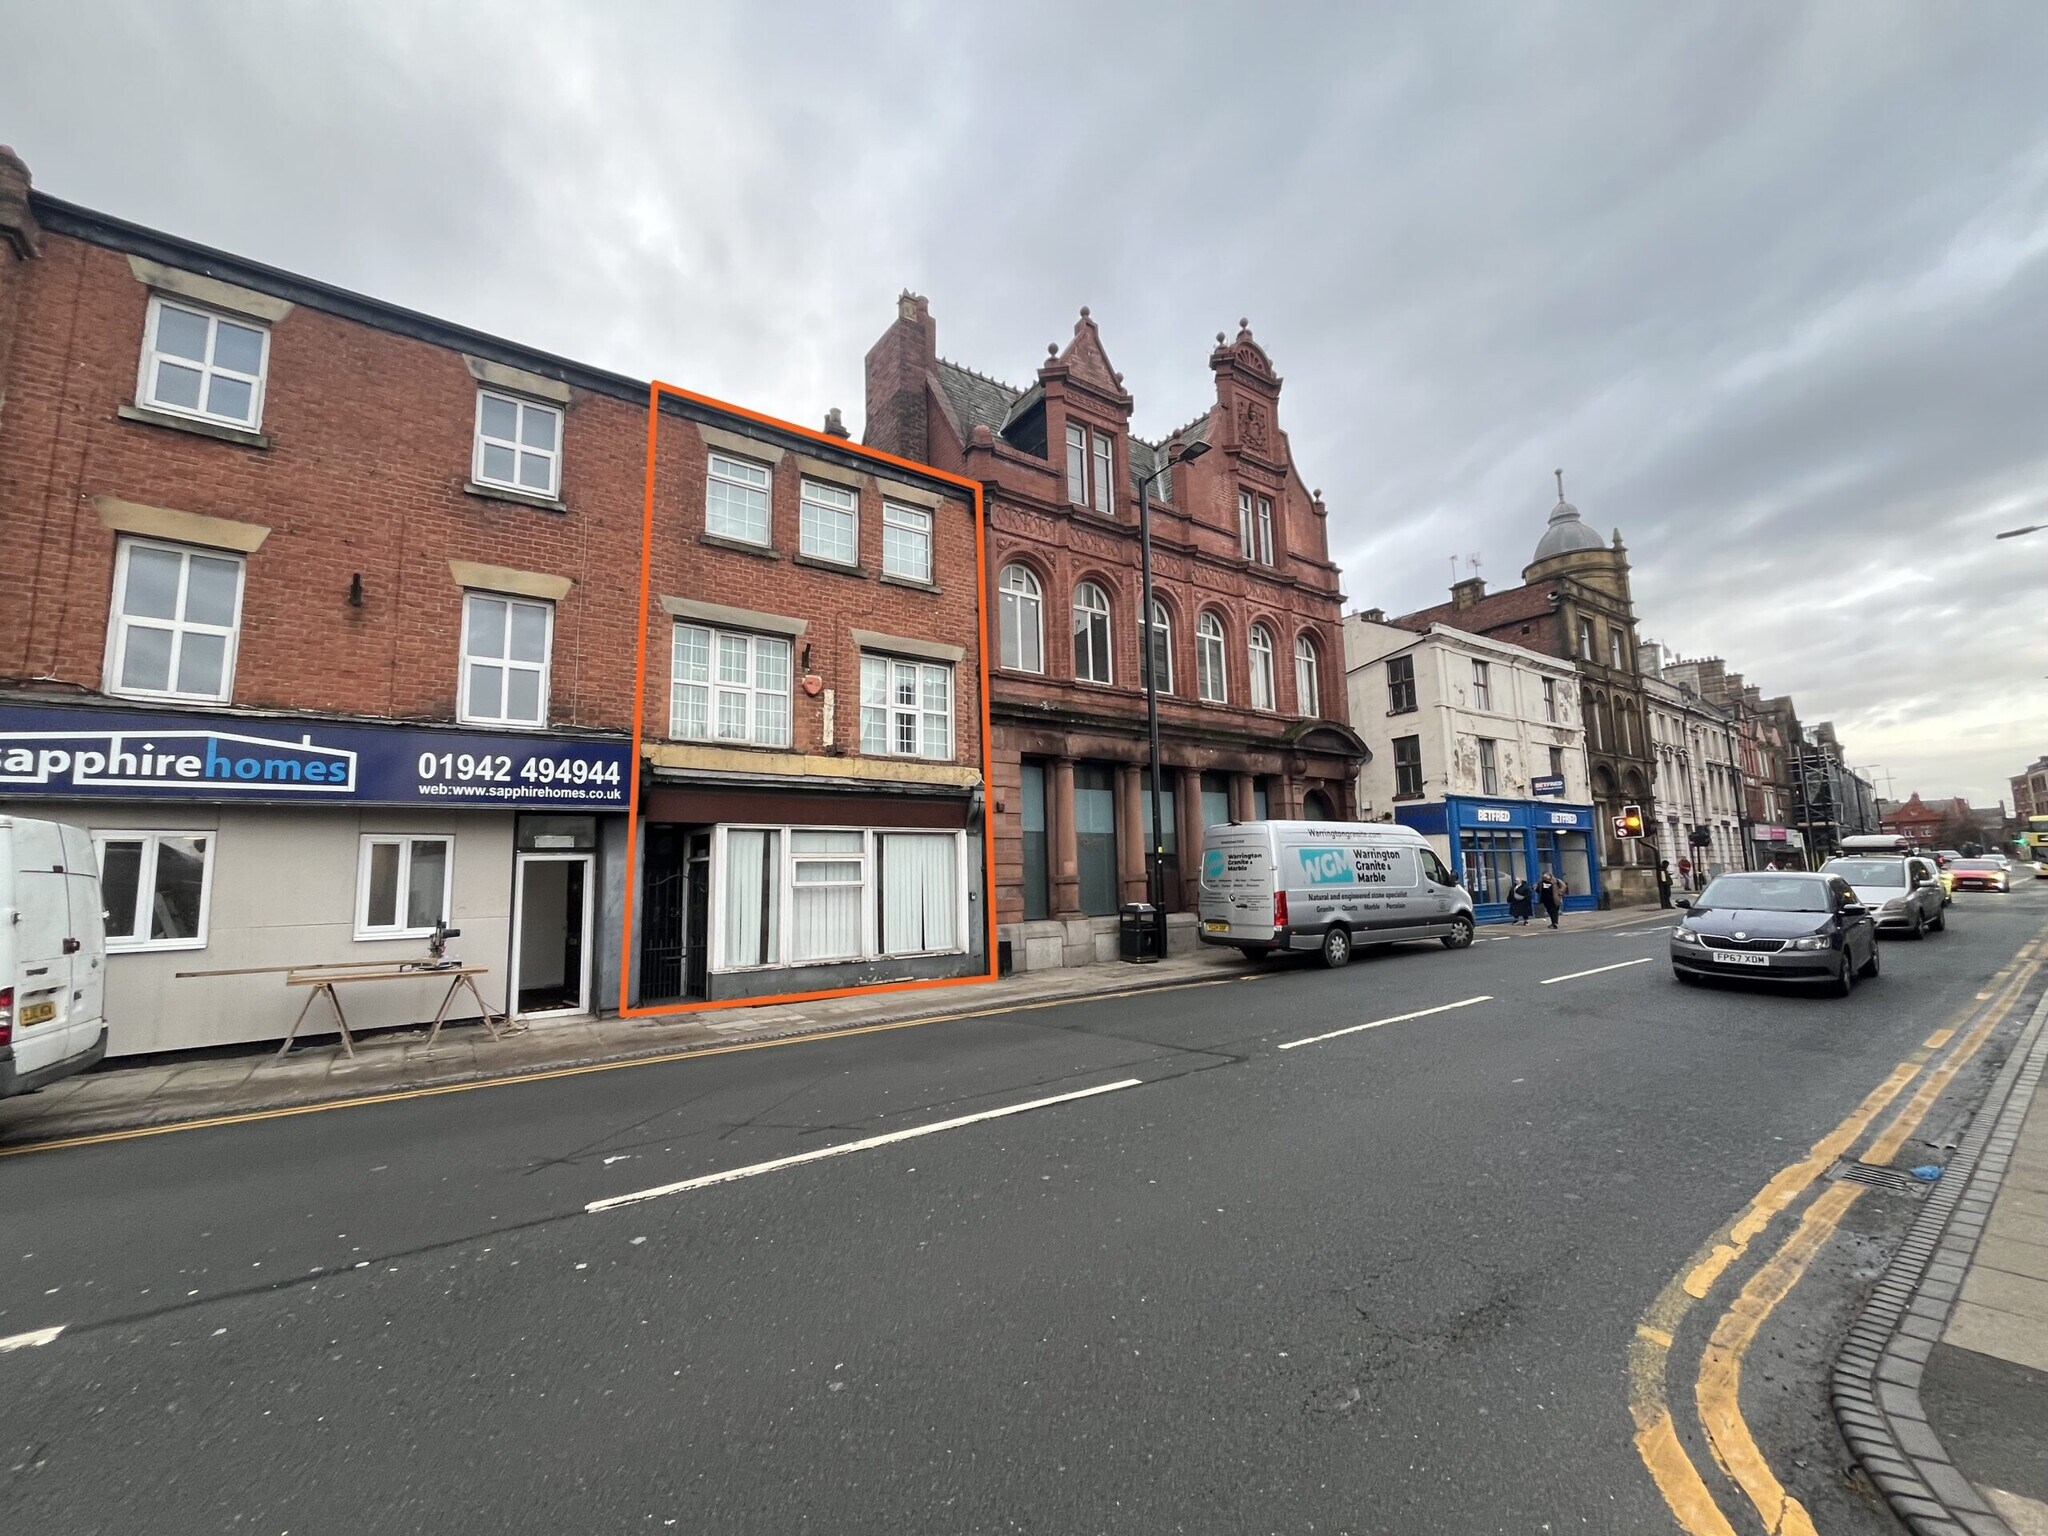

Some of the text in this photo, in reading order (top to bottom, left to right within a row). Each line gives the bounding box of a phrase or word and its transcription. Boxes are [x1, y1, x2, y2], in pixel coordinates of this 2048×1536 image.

[0, 736, 346, 784] apphirehomes
[419, 752, 620, 785] 01942 494944
[1535, 780, 1563, 788] BETFRED
[419, 783, 621, 800] web:www.sapphirehomes.co.uk
[1478, 809, 1510, 822] BETFRED
[1551, 812, 1577, 824] BETFRED
[1353, 849, 1400, 861] Warrington
[1301, 851, 1352, 884] WGM
[1356, 861, 1386, 871] Granite
[1358, 873, 1386, 882] Marble
[1308, 893, 1329, 901] Natural
[1342, 892, 1370, 901] engineered
[1386, 891, 1408, 899] specialist
[1316, 905, 1335, 913] Granite
[1717, 953, 1742, 962] FP67
